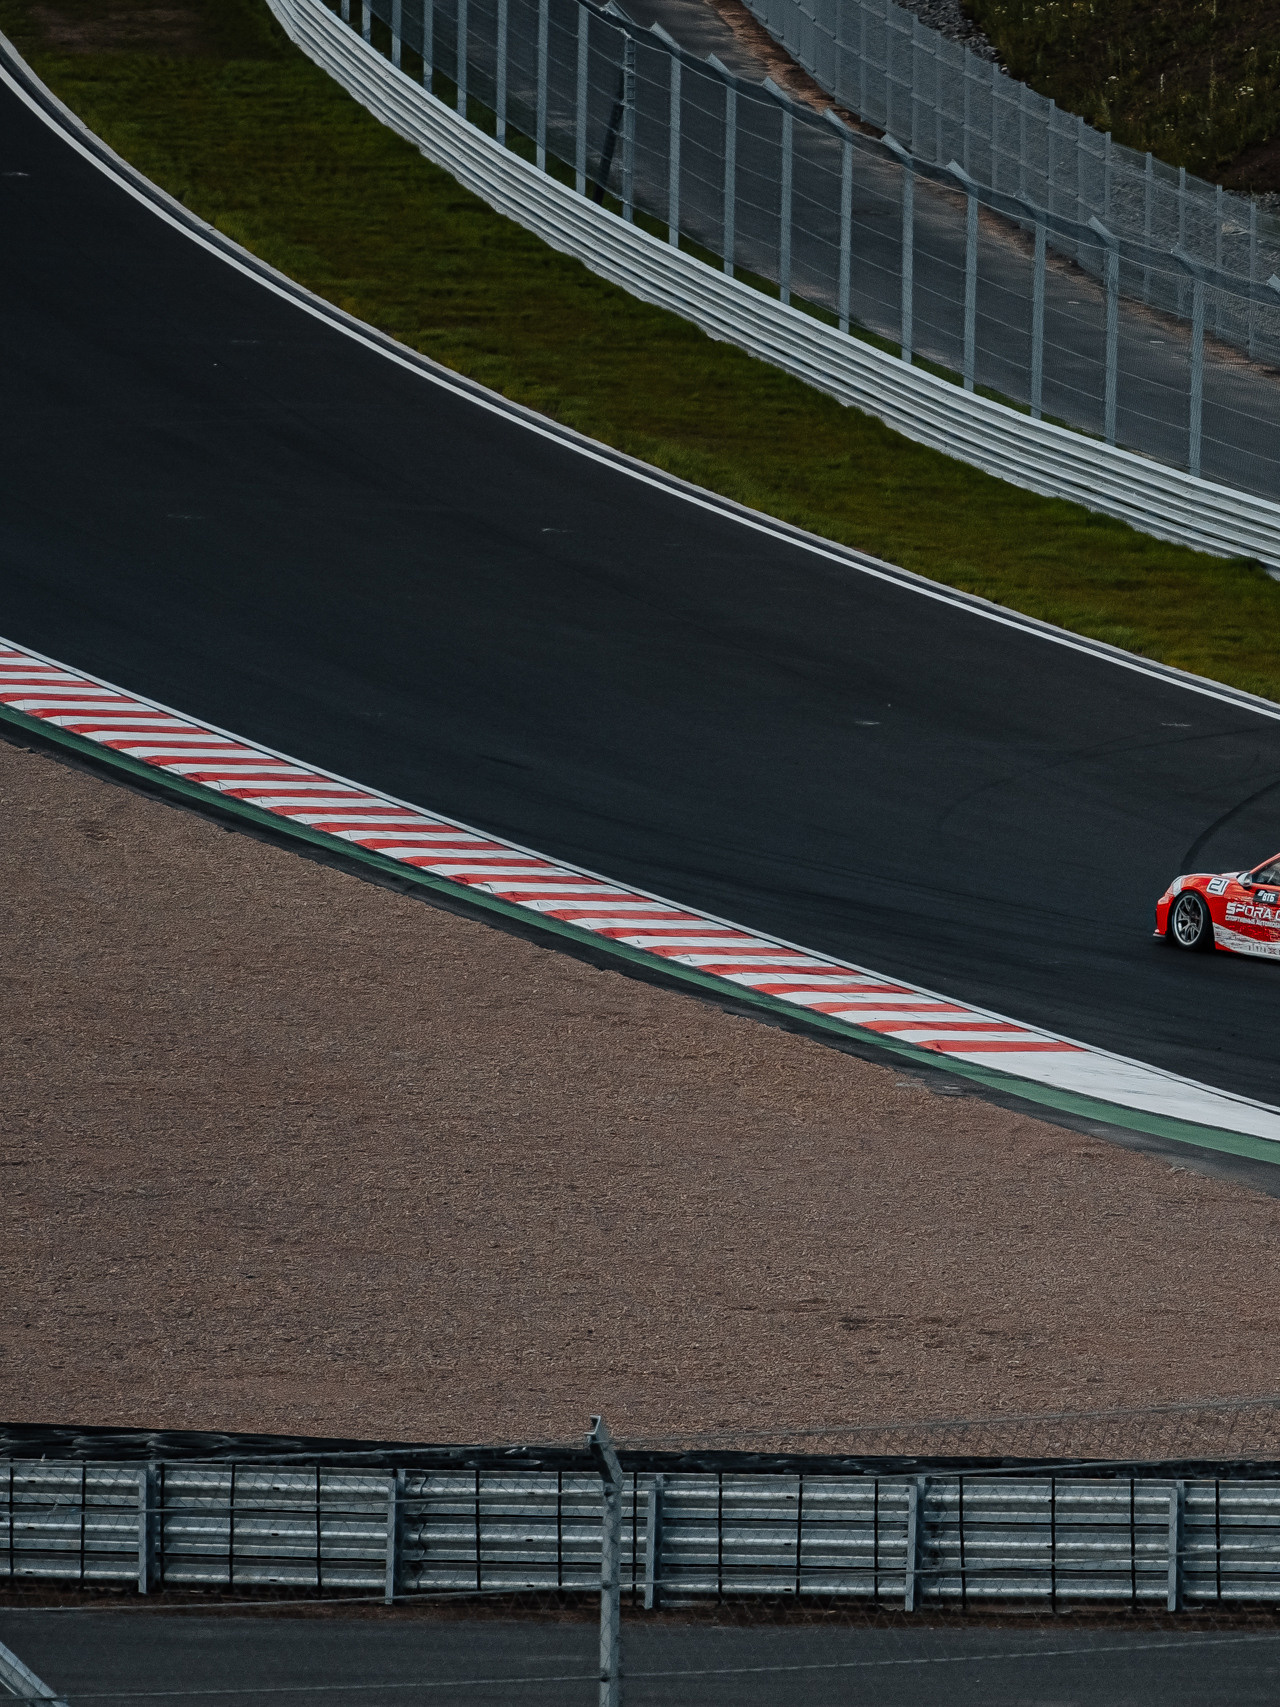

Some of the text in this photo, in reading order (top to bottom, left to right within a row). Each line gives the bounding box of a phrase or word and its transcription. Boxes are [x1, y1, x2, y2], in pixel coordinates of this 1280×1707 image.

[1208, 878, 1228, 893] 21
[1262, 892, 1276, 902] ВТБ
[1226, 902, 1271, 919] SPORA
